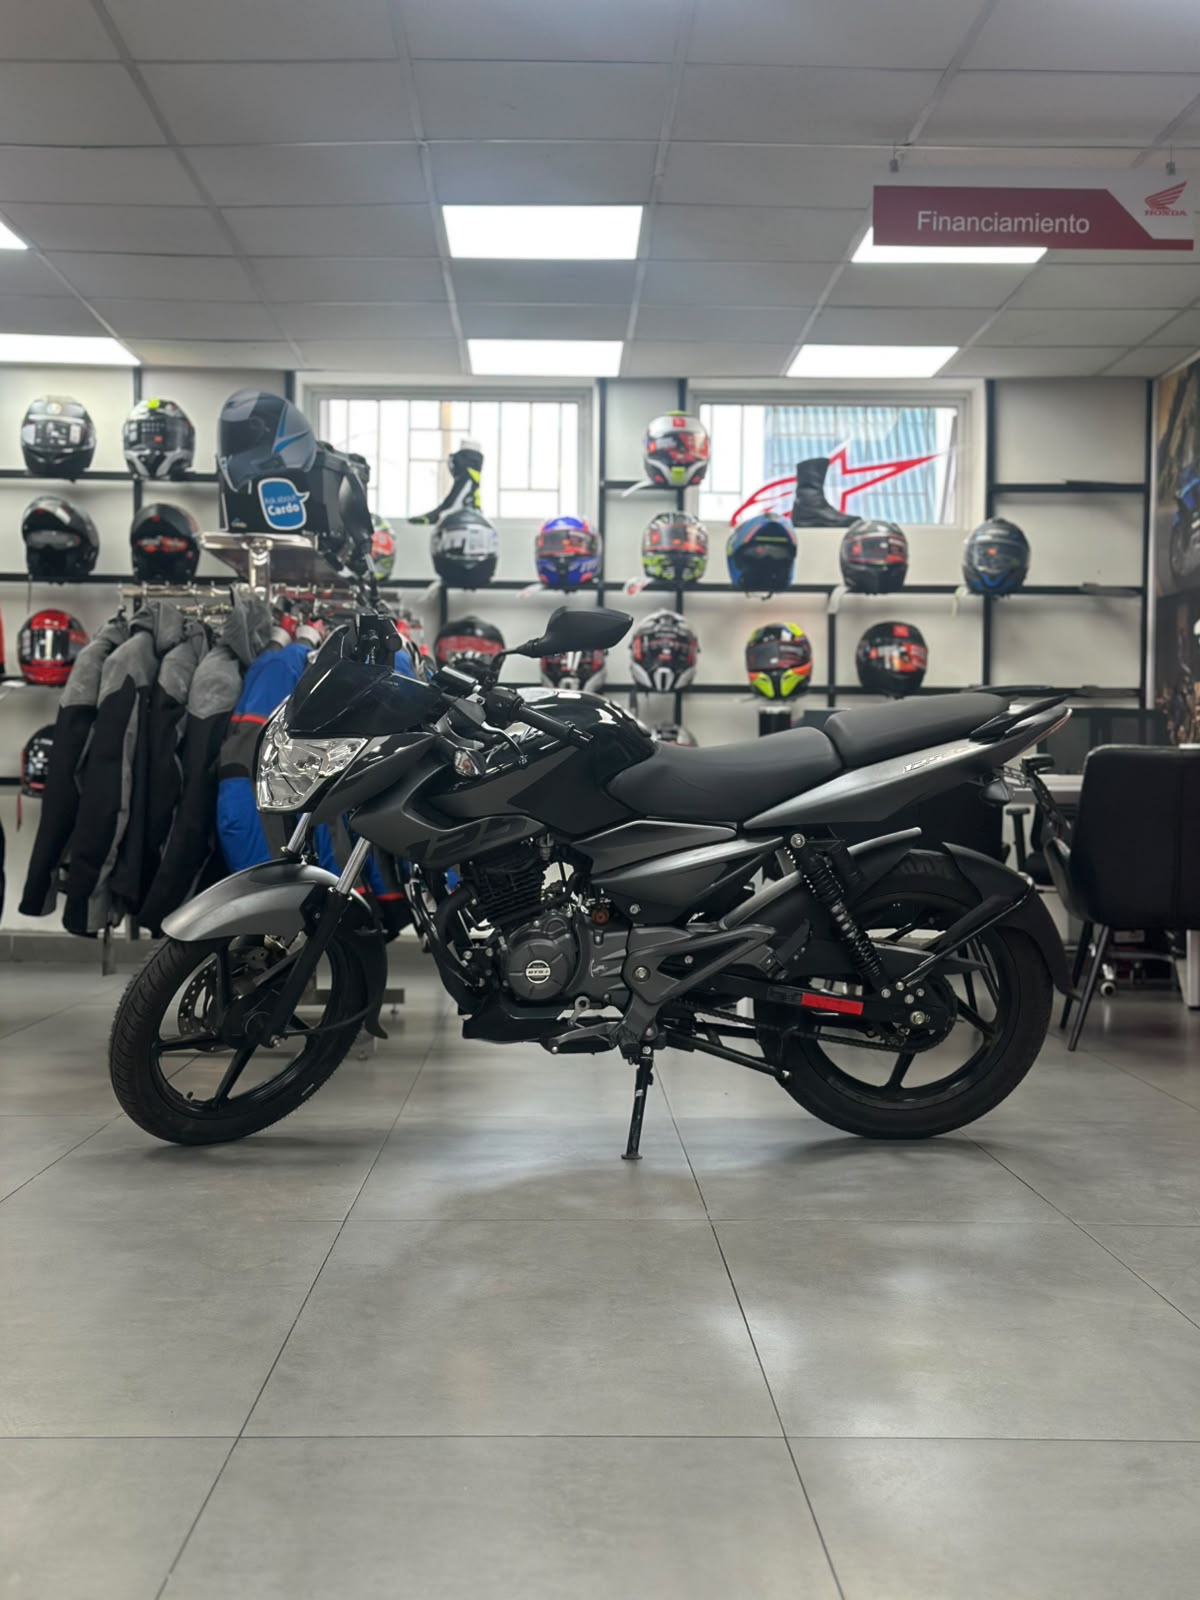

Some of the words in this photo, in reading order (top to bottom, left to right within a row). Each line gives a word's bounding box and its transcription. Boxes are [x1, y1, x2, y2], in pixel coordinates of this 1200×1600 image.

[1144, 209, 1188, 217] HONDA
[917, 210, 1090, 234] Financiamiento
[267, 502, 300, 516] Cardo
